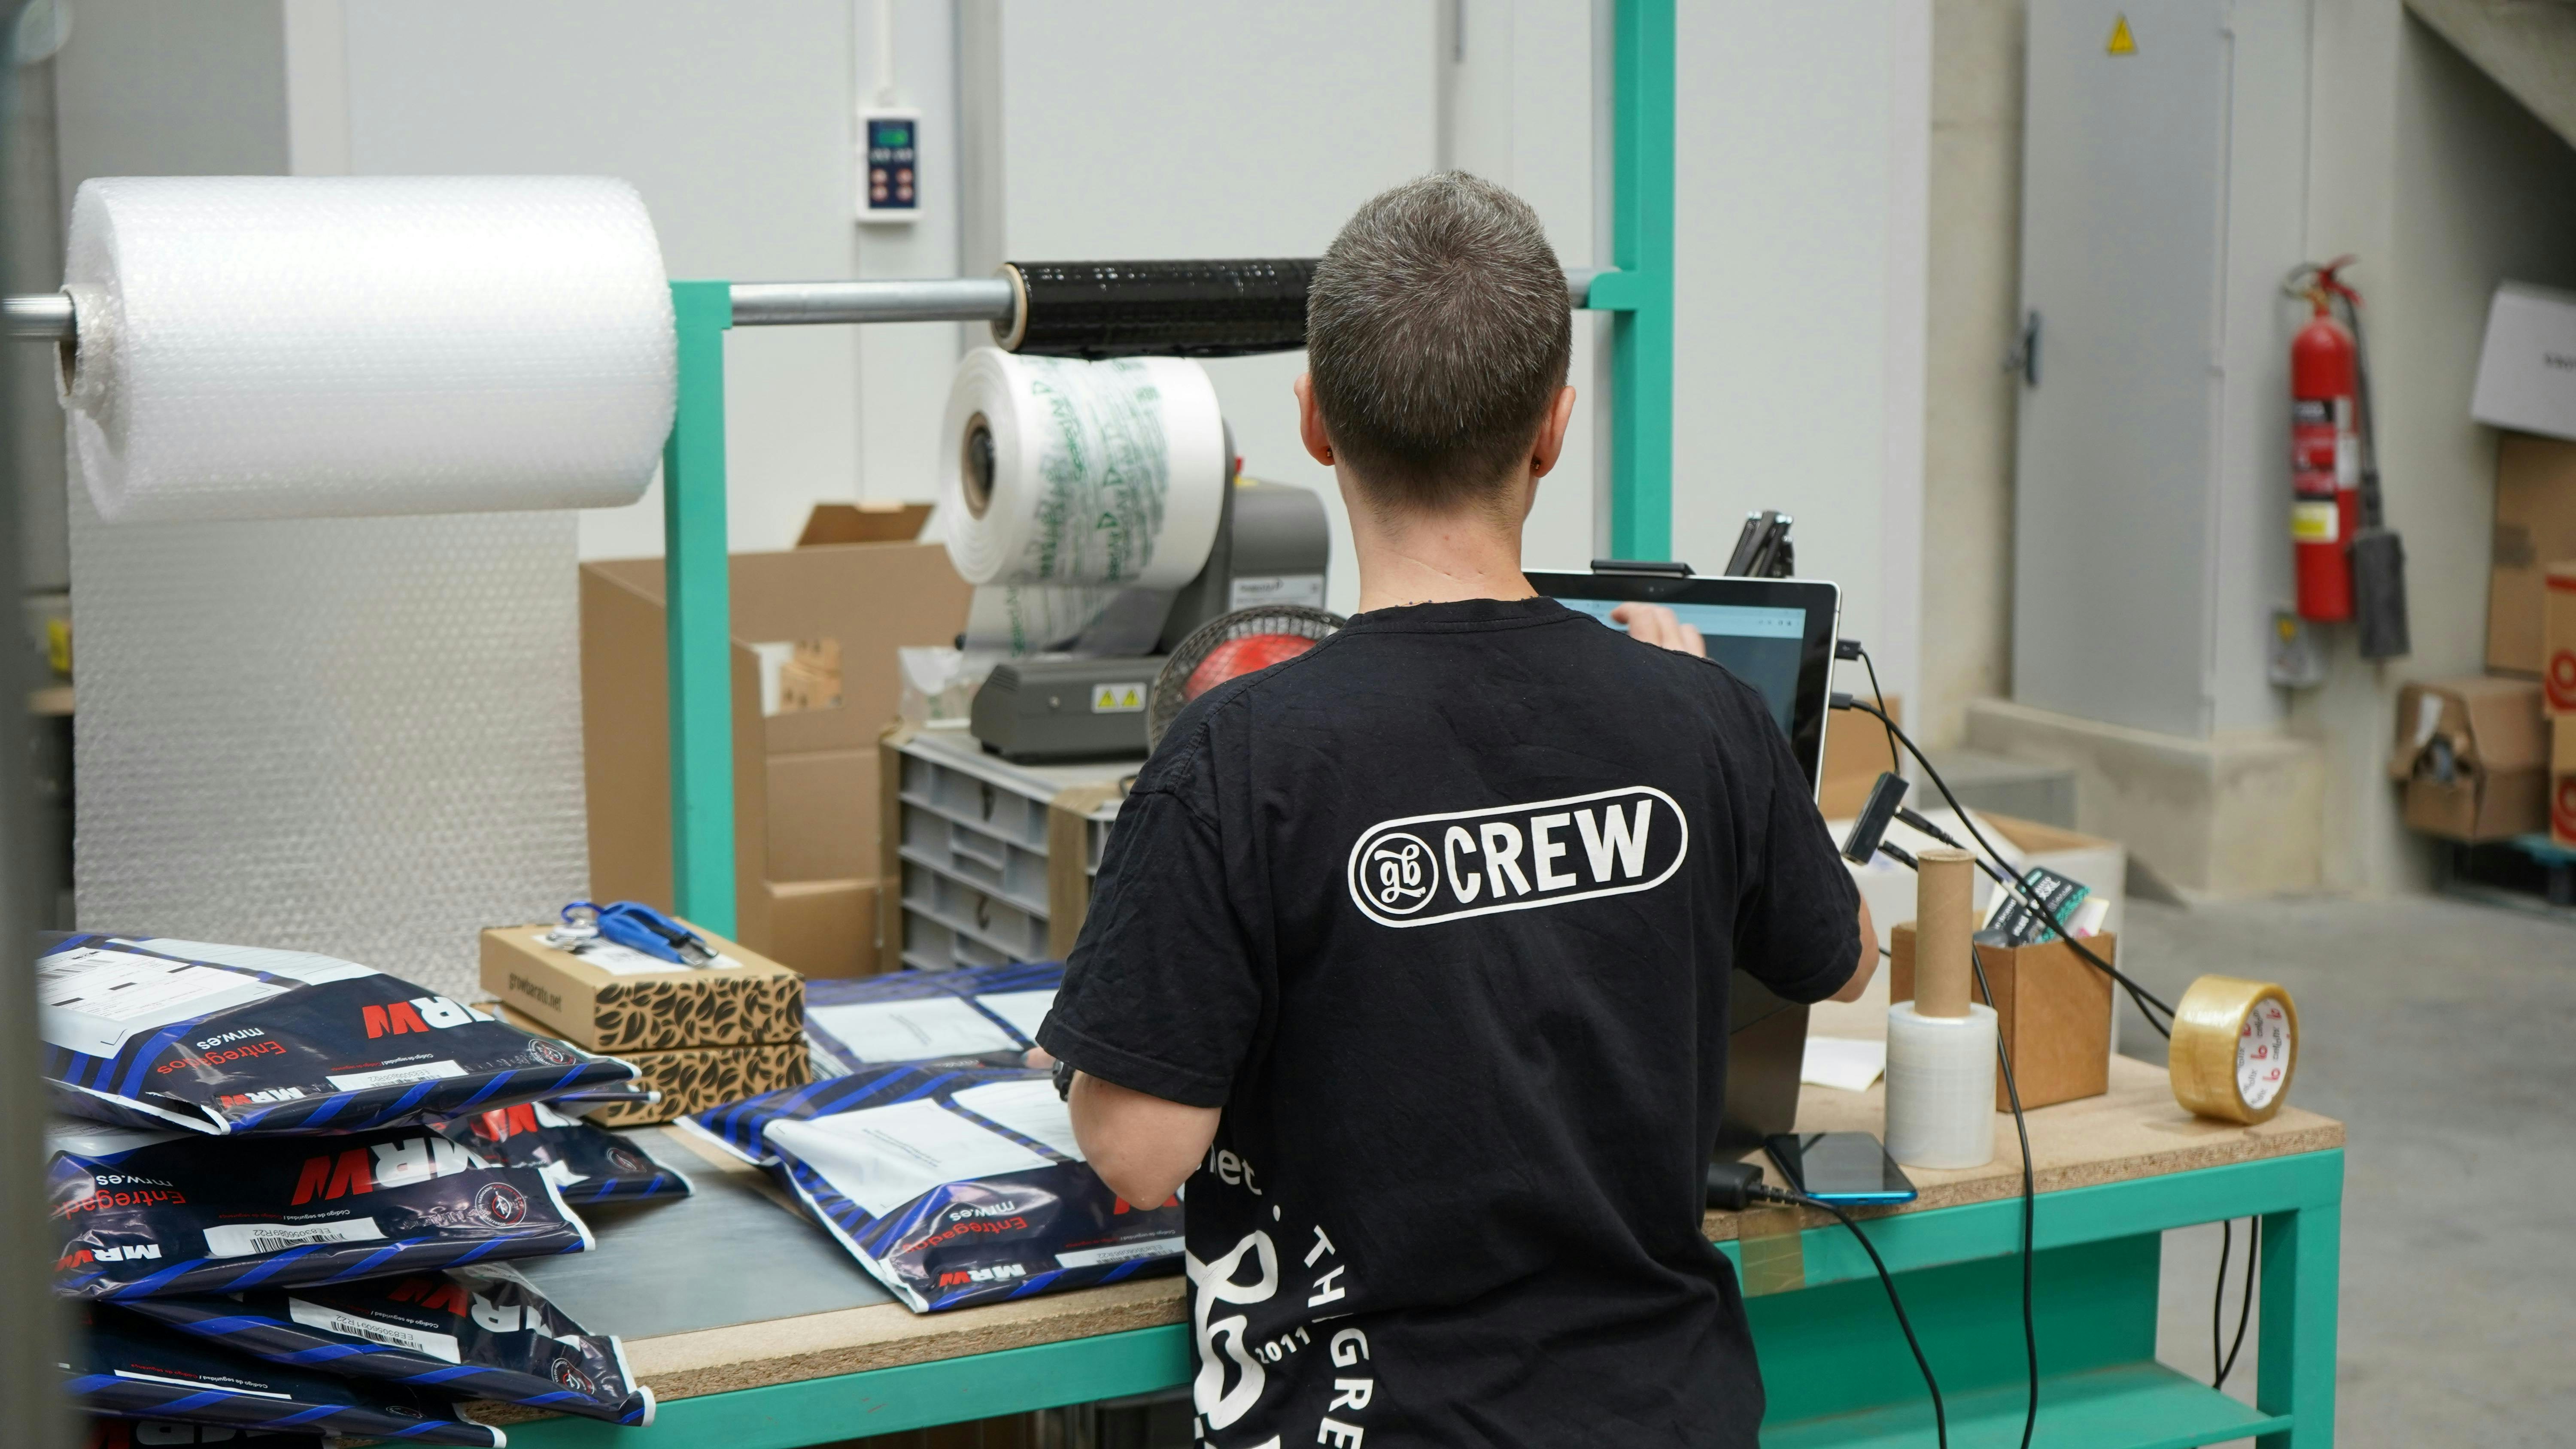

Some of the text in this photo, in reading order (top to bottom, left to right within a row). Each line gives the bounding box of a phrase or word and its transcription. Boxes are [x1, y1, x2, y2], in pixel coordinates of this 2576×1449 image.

[1445, 799, 1653, 904] CREW
[508, 972, 562, 1012] growbarato.net
[197, 1027, 264, 1050] mrw.es
[156, 1040, 287, 1075] Entregados
[219, 1086, 307, 1109] MRW
[96, 1174, 173, 1187] mrw.es
[326, 1210, 350, 1218] Código
[949, 1200, 1015, 1222] mrw.es
[902, 1216, 1029, 1255] Entregados
[939, 1264, 1026, 1288] MRW
[374, 1312, 405, 1322] seguridad
[415, 1319, 439, 1329] Código
[1255, 1326, 1311, 1364] 2011
